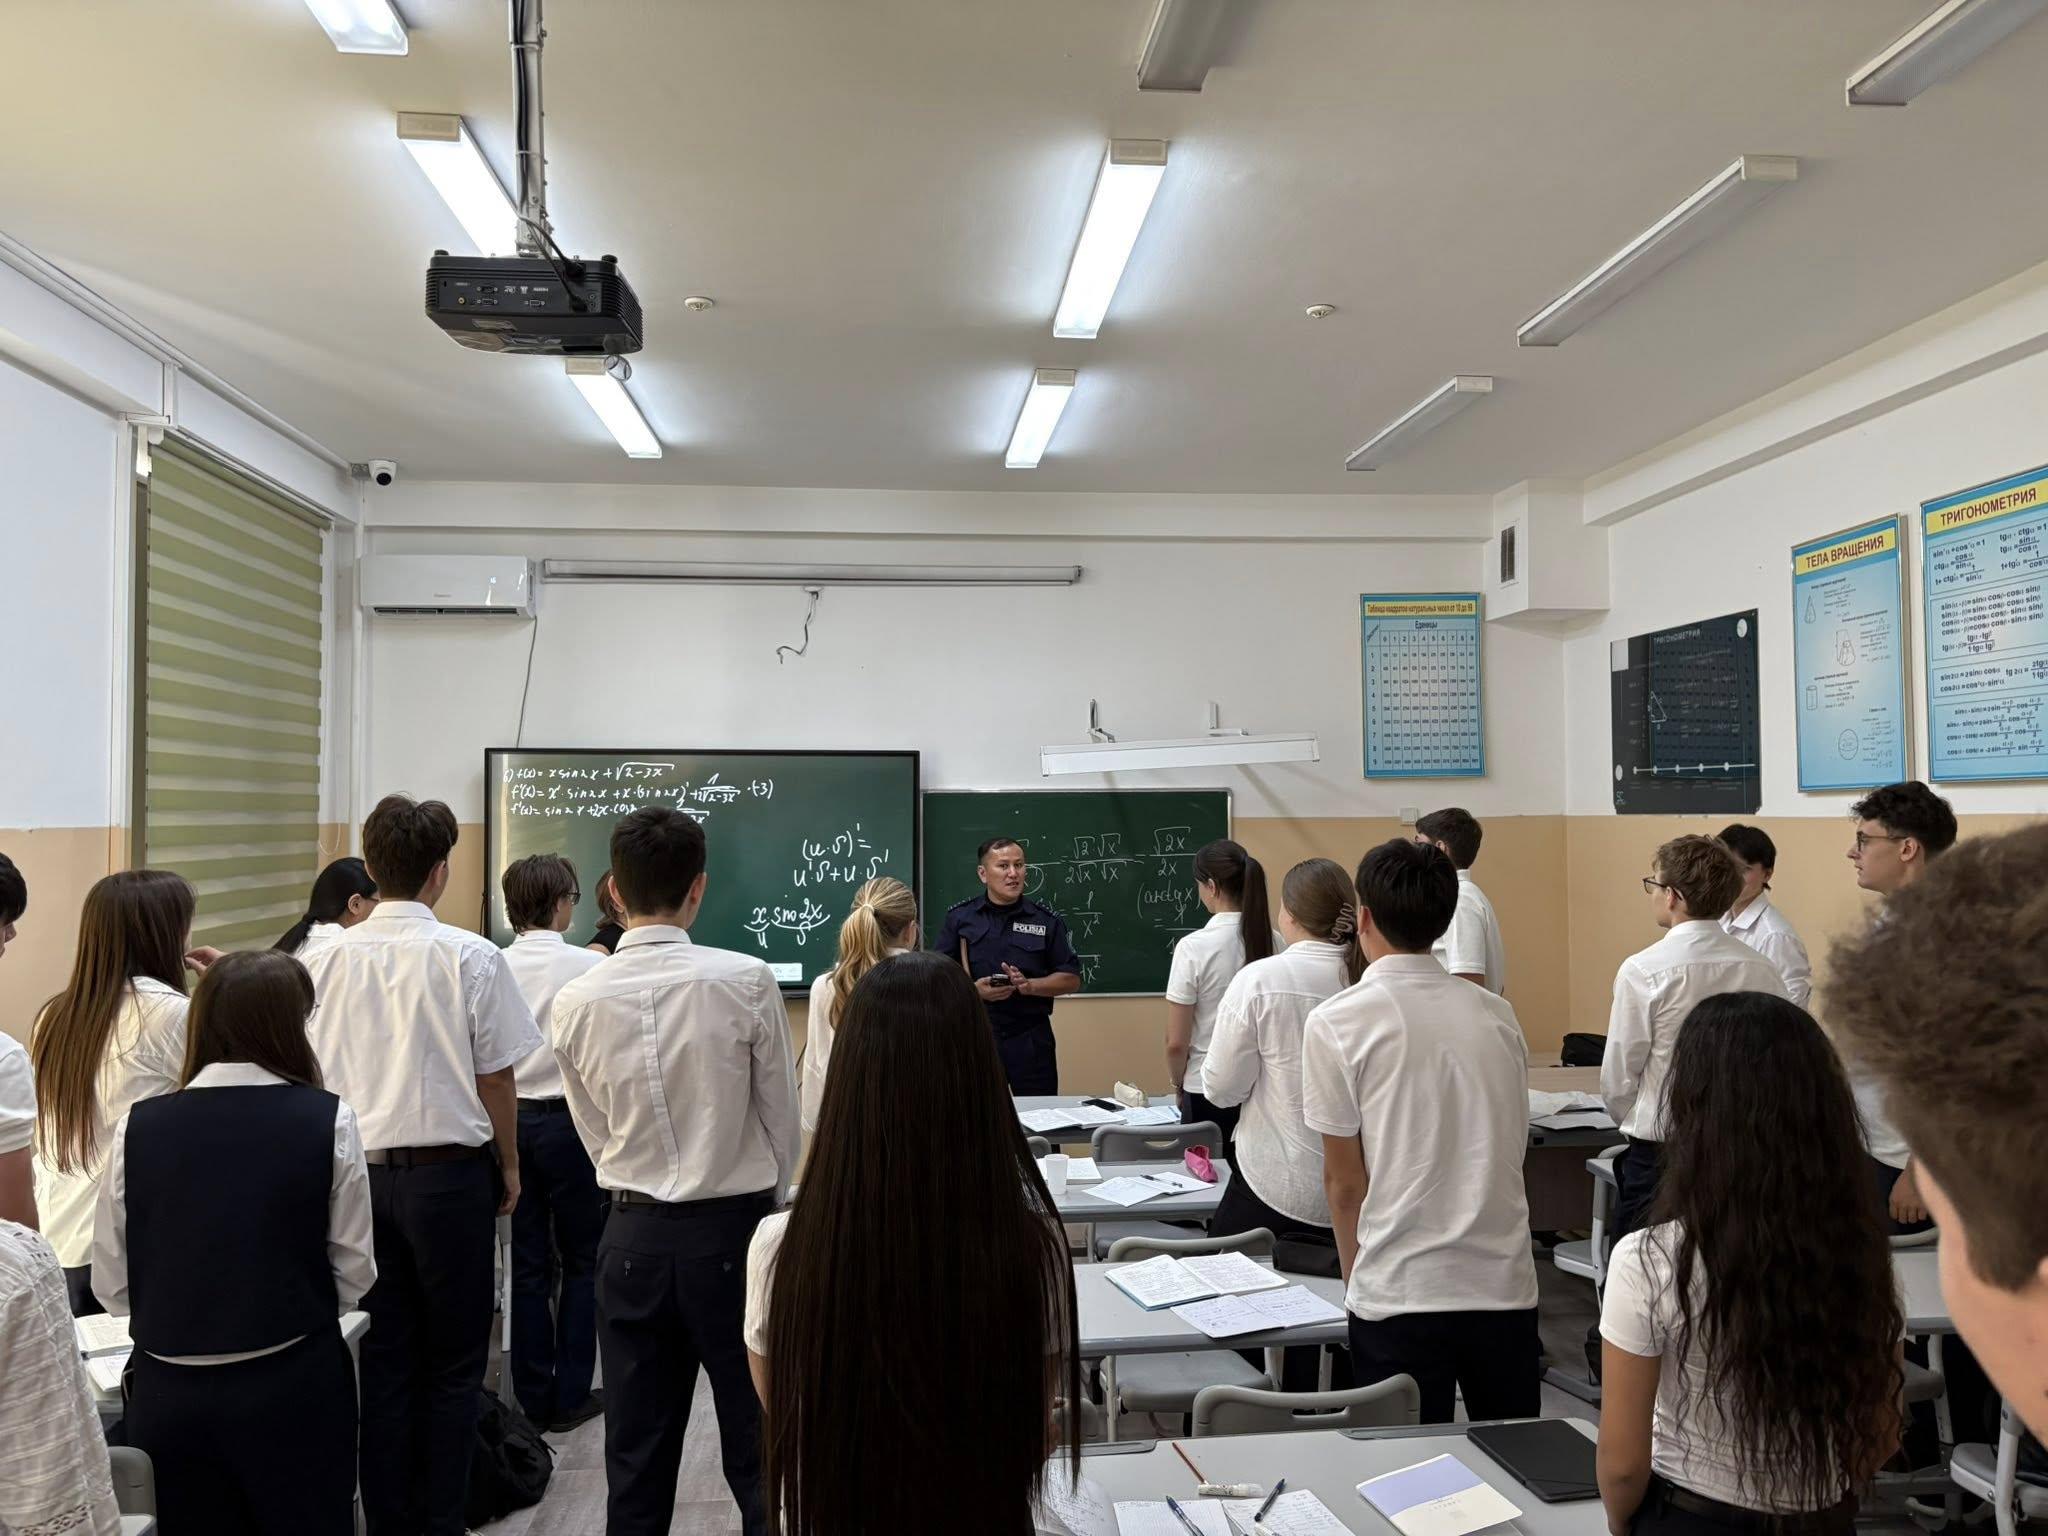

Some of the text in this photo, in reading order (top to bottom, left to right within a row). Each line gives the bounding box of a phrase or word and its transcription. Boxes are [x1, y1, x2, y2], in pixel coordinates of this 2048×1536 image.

[1940, 488, 2036, 526] ТРИГОНОМЕТРИЯ
[1806, 535, 1884, 568] ТЕЛА ВРАЩЕНИЯ
